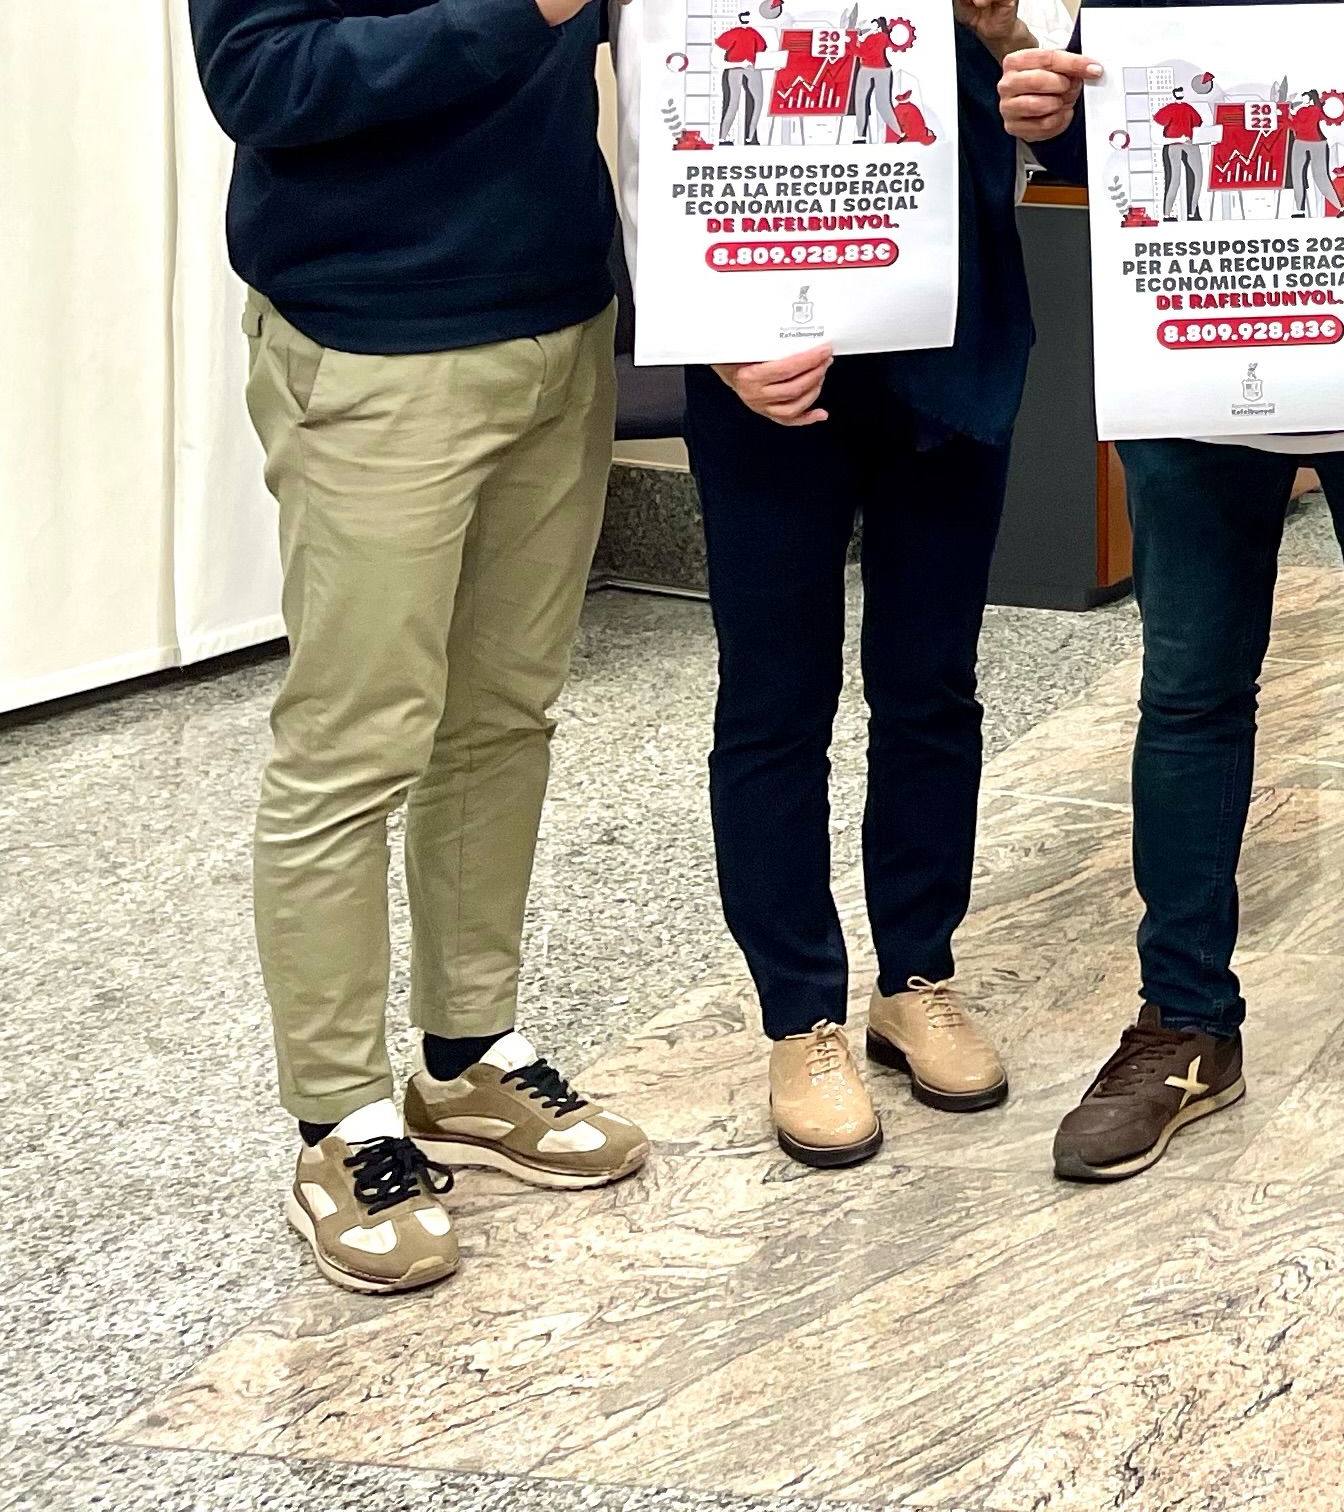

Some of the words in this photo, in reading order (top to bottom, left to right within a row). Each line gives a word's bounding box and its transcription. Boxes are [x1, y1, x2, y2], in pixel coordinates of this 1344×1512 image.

[819, 31, 840, 42] 20
[818, 44, 839, 56] 22
[1251, 104, 1272, 116] 20
[1251, 117, 1272, 129] 22
[687, 164, 858, 180] PRESSUPOSTOS
[673, 184, 713, 198] PER
[721, 183, 735, 197] A
[744, 183, 768, 198] LA
[831, 199, 835, 212] I
[843, 196, 918, 212] SOCIAL
[707, 218, 734, 233] DE
[742, 214, 899, 232] RAFELBUNYOL.
[713, 243, 891, 265] 8.809.928,83€
[1135, 239, 1299, 257] PRESSUPOSTOS
[1123, 260, 1161, 275] PER
[1168, 260, 1182, 274] A
[1189, 259, 1213, 274] LA
[1273, 274, 1278, 288] I
[1157, 295, 1183, 310] DE
[1189, 290, 1344, 309] RAFELBUNYOL.
[1164, 320, 1336, 342] 8.809.928,83€
